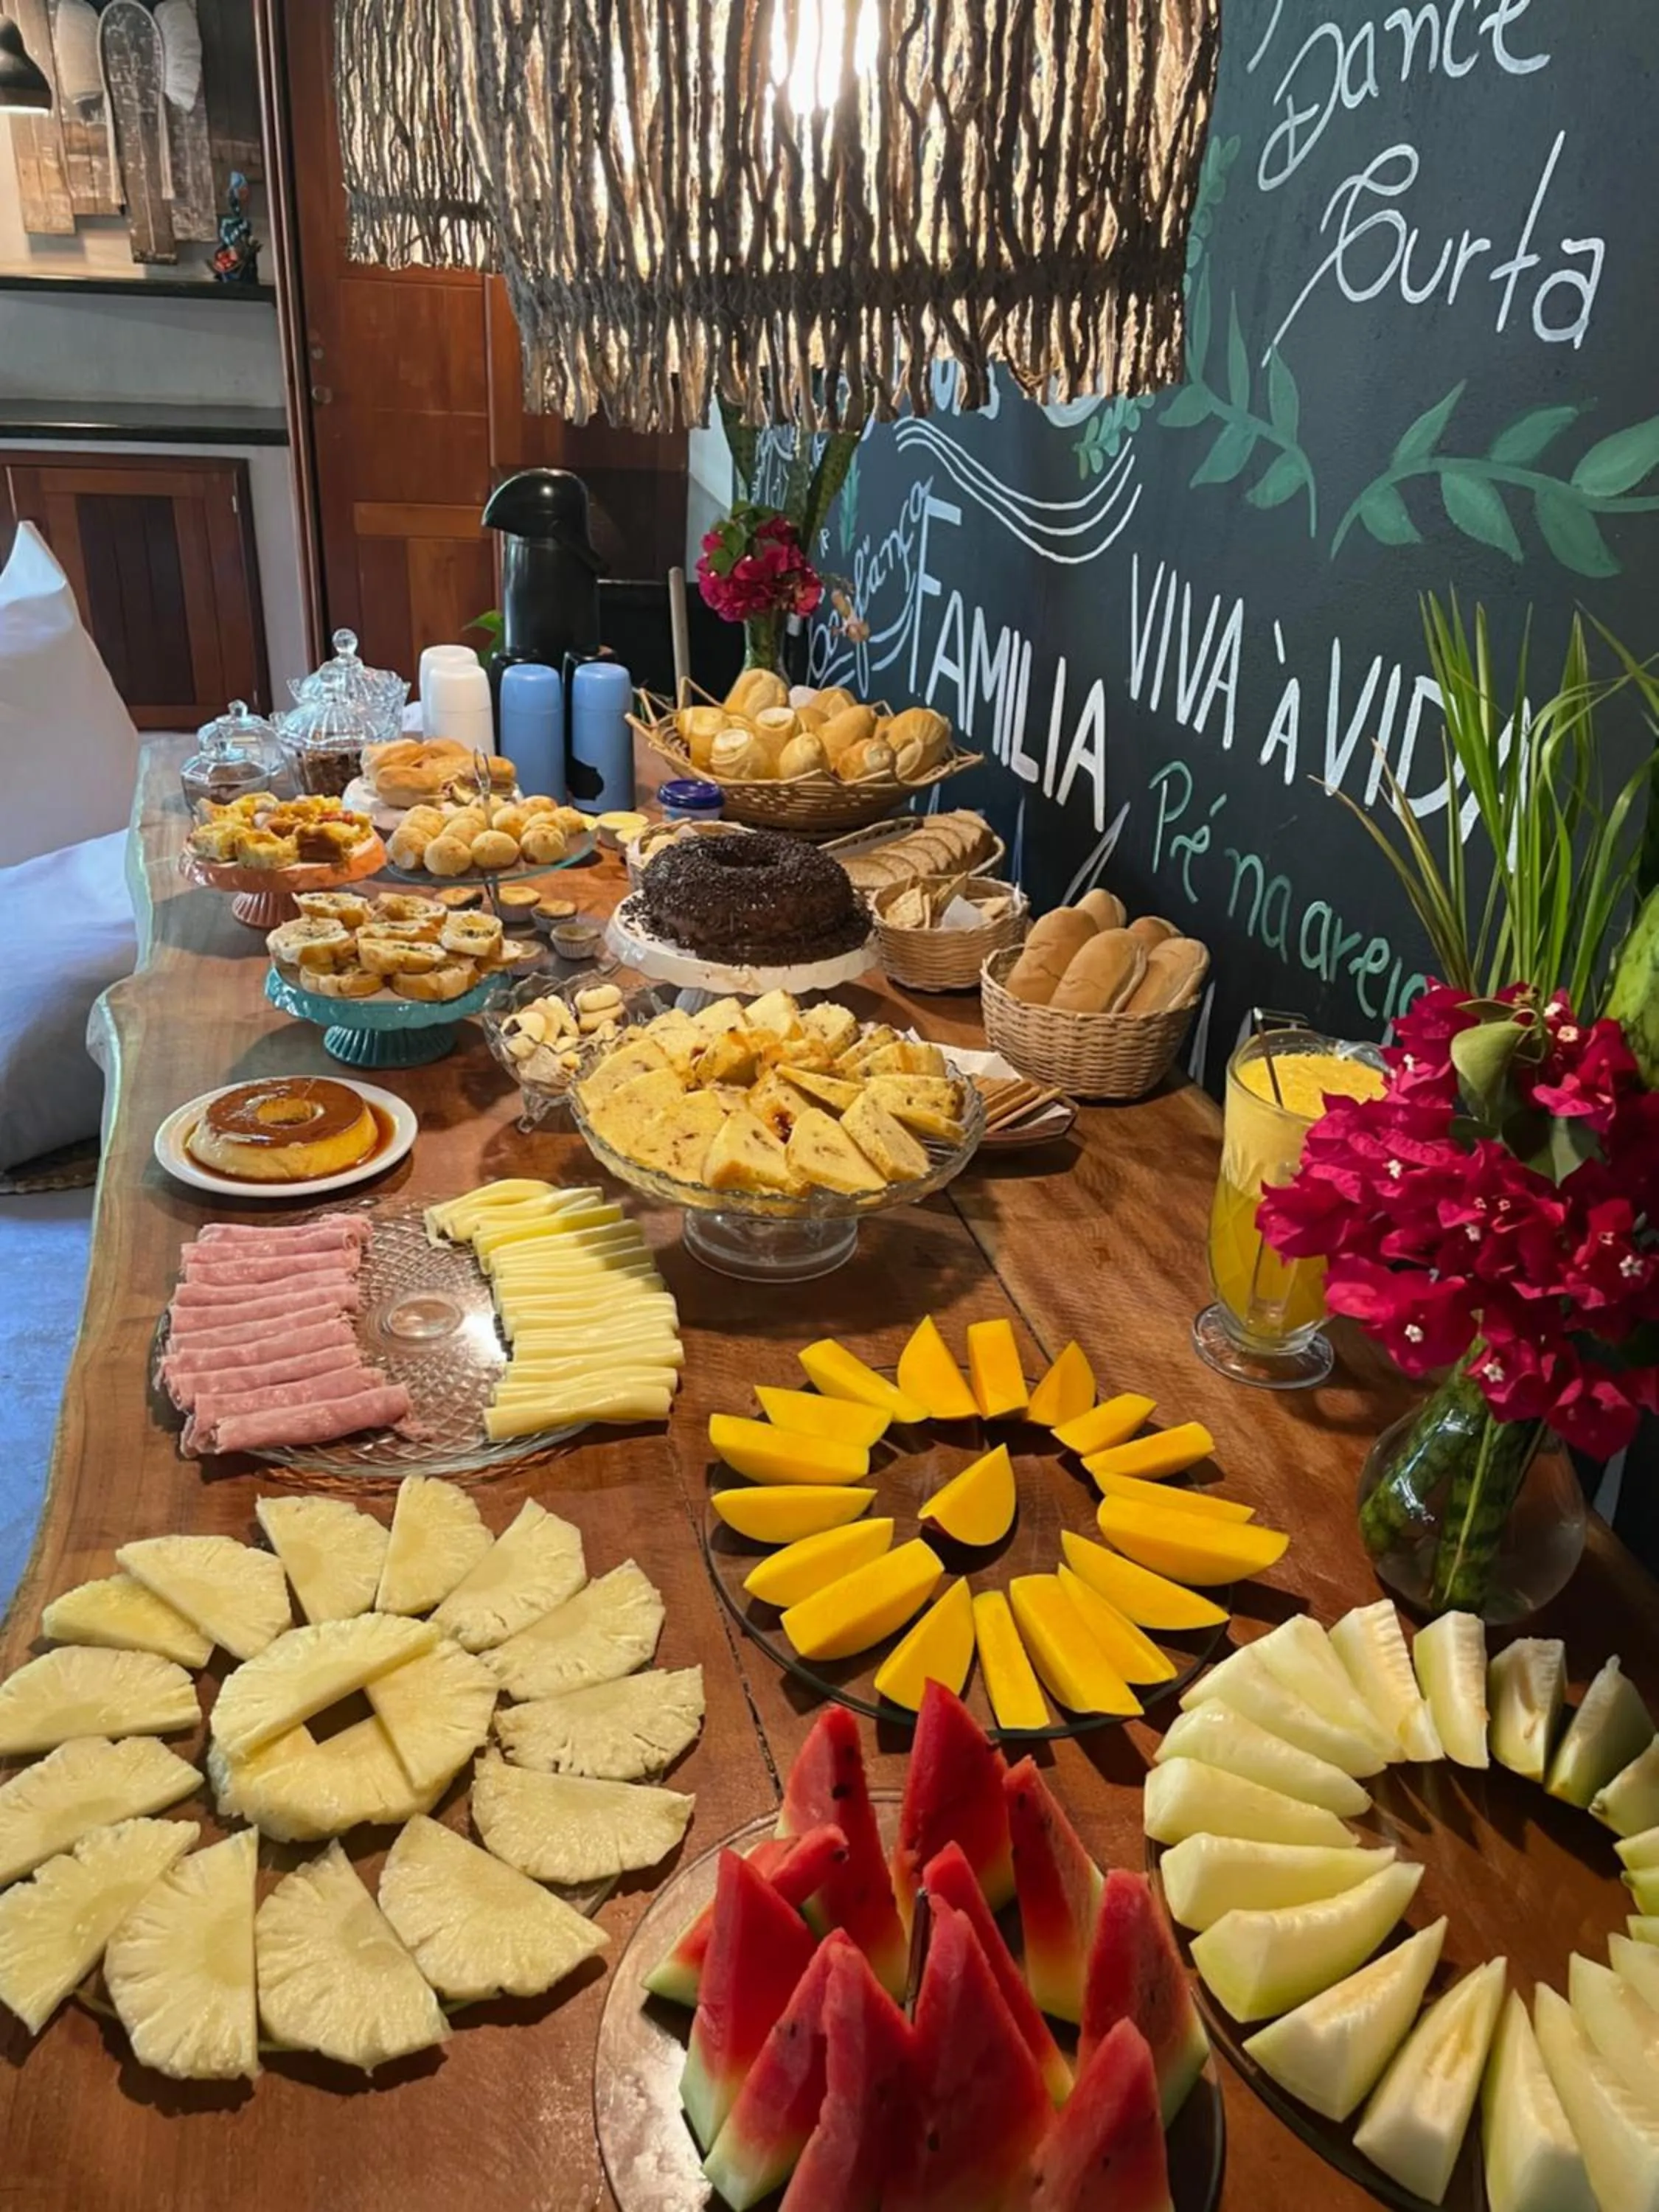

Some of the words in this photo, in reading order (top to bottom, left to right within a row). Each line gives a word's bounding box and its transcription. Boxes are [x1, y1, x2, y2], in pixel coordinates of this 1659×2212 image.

[909, 493, 1103, 835] FAMILIA
[1130, 552, 1244, 751] VIVA
[1259, 619, 1300, 785] À
[1148, 760, 1227, 903] Pé
